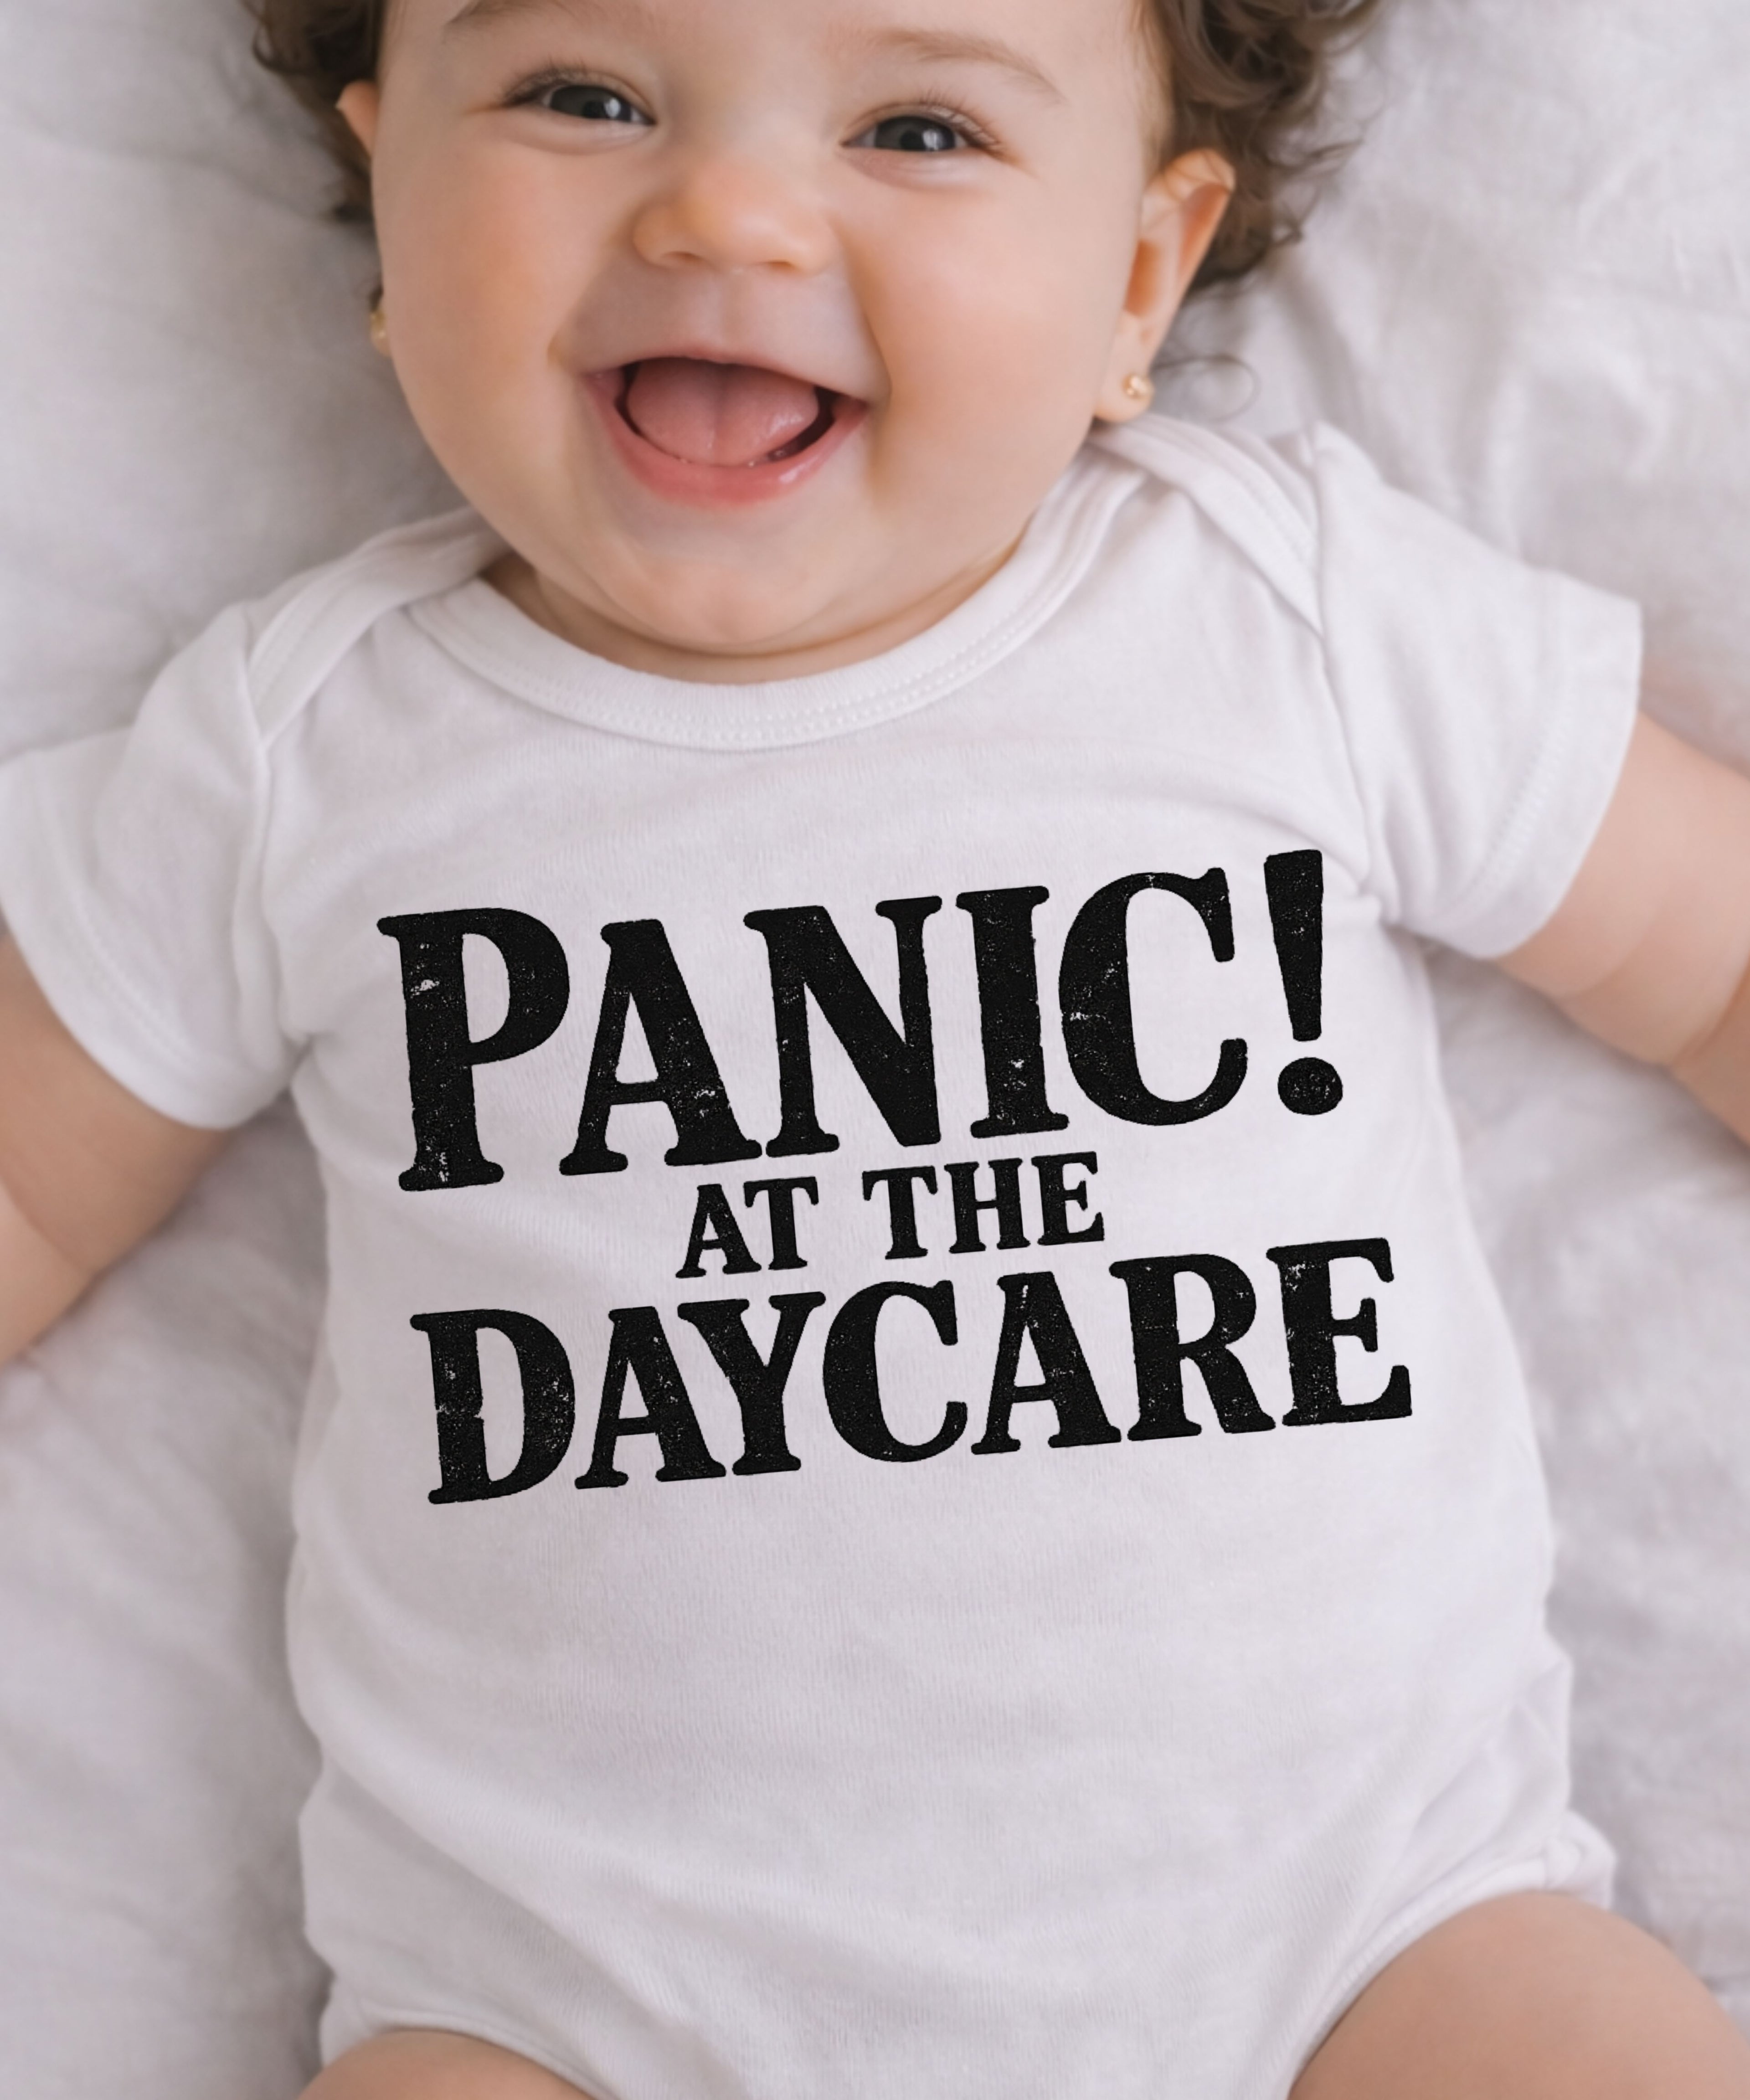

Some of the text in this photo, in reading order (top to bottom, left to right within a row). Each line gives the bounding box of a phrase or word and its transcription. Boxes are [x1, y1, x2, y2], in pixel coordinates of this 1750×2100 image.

[376, 849, 1343, 1192] PANIC!
[675, 1151, 1105, 1279] AT THE
[409, 1237, 1413, 1505] DAYCARE
